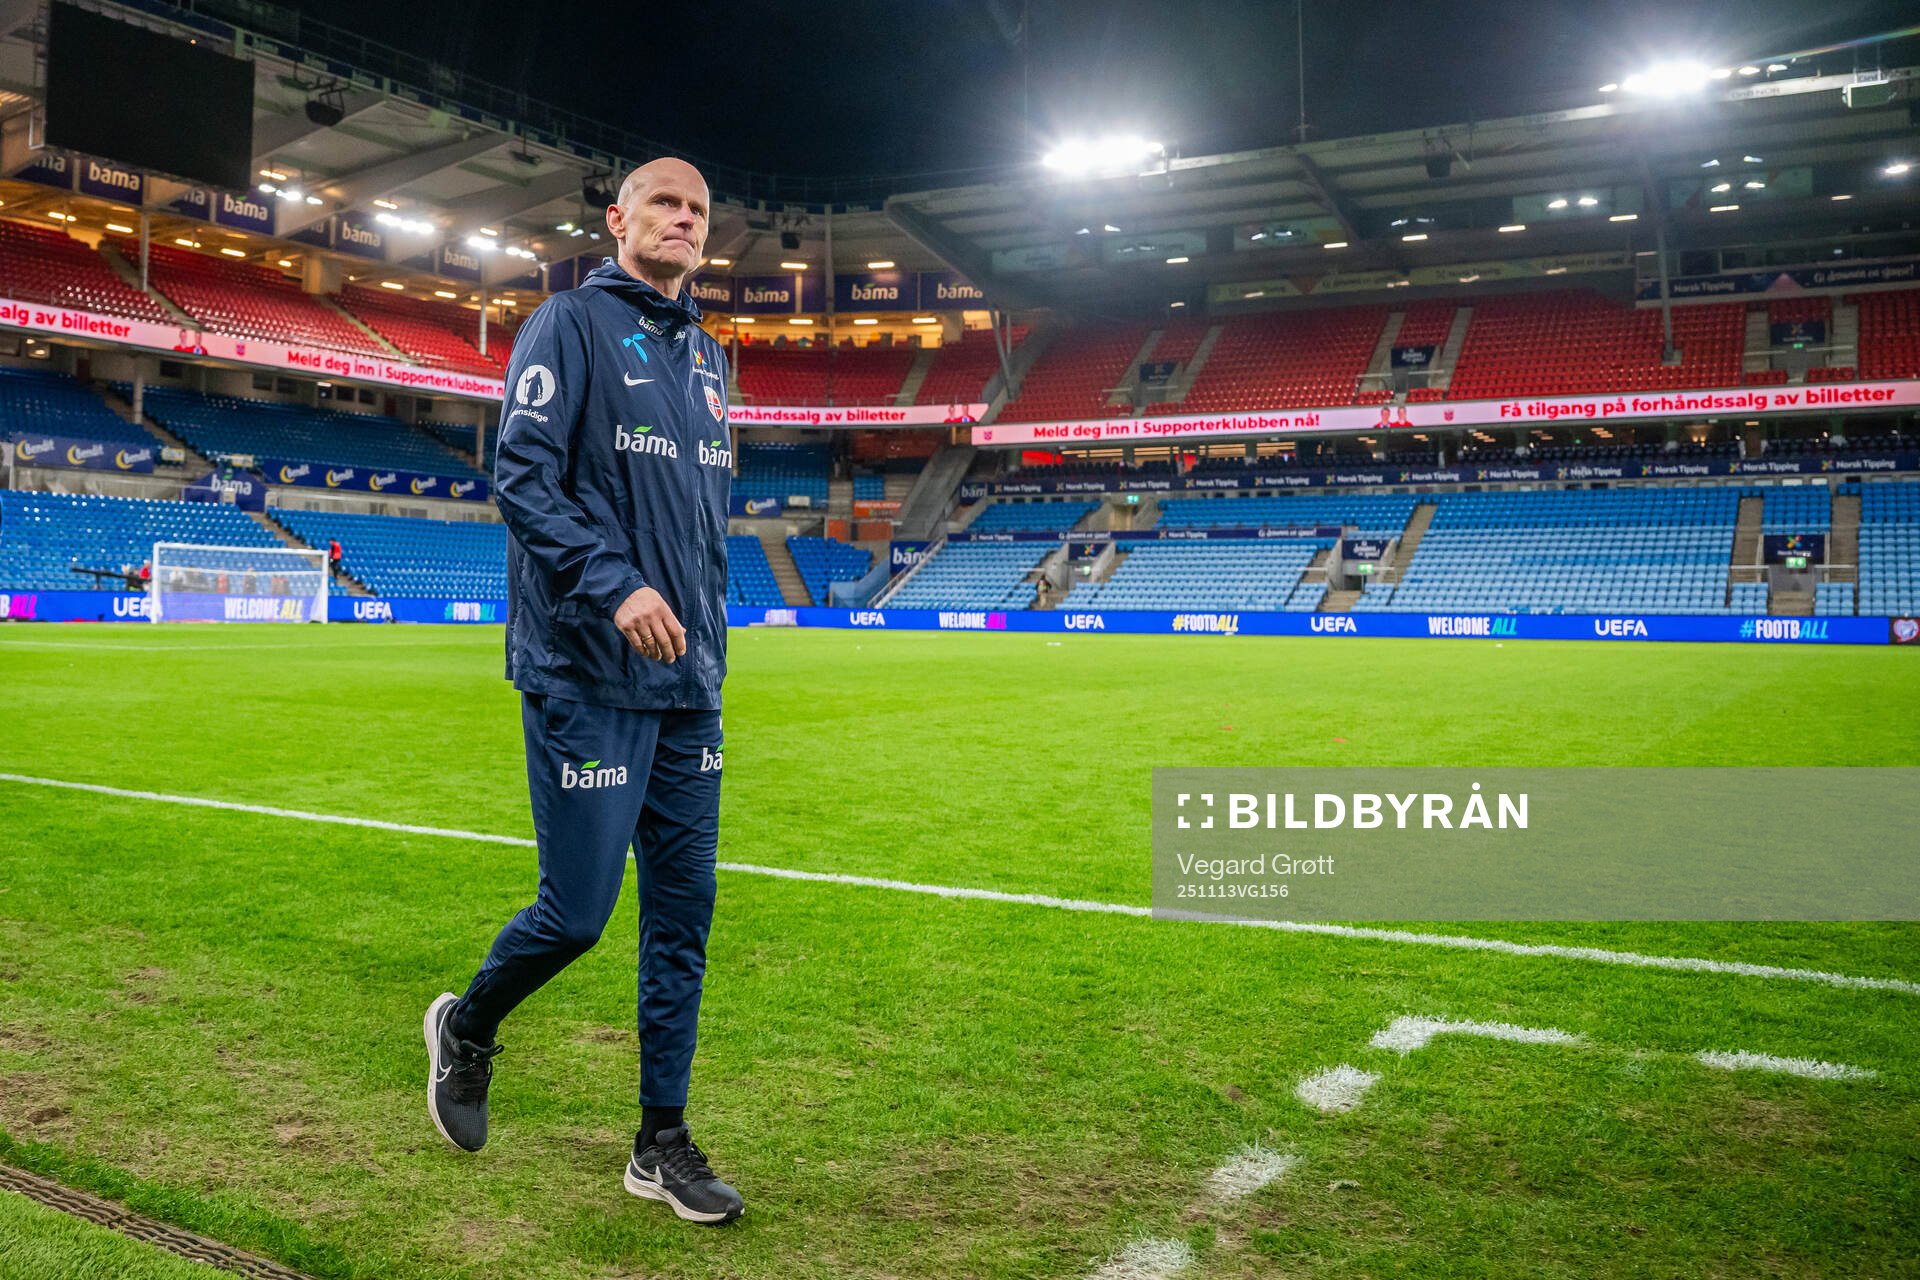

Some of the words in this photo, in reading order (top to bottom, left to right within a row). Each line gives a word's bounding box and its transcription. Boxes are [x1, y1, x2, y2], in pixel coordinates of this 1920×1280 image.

[88, 161, 141, 191] bama
[223, 193, 268, 221] bama
[341, 222, 381, 247] bama
[444, 250, 480, 271] bama
[690, 281, 730, 302] bama
[744, 286, 790, 304] bama
[851, 283, 899, 301] bama
[0, 304, 29, 326] alg
[35, 314, 57, 326] av
[61, 313, 131, 338] billetter
[639, 316, 663, 337] bama
[288, 351, 321, 367] Meld
[325, 357, 350, 376] deg
[354, 359, 375, 376] inn
[386, 366, 494, 395] Supporterklubben
[1501, 402, 1522, 417] Få
[1528, 401, 1597, 419] tilgang
[1602, 396, 1627, 415] på
[1632, 393, 1768, 412] forhåndssalg
[1774, 394, 1800, 405] av
[1806, 387, 1896, 404] billetter
[728, 408, 821, 425] orhåndssalg
[825, 411, 842, 422] av
[846, 409, 906, 422] billetter
[1034, 425, 1069, 438] Meld
[1073, 423, 1101, 439] deg
[1106, 421, 1130, 435] inn
[1134, 421, 1139, 434] i
[1143, 413, 1289, 435] Supporterklubben
[1294, 412, 1320, 427] nå!
[615, 424, 678, 459] bama
[698, 440, 733, 469] bam
[224, 598, 280, 619] WELCOME
[280, 598, 303, 619] ALL
[354, 601, 393, 620] UEFA
[850, 612, 885, 626] UEFA
[939, 612, 986, 629] WELCOME
[986, 613, 1007, 629] ALL
[1064, 614, 1105, 630] UEFA
[1172, 614, 1239, 632] #FOOTBALL
[1311, 617, 1358, 632] UEFA
[1428, 617, 1491, 636] WELCOME
[1491, 617, 1518, 636] ALL
[1594, 619, 1649, 637] UEFA
[1739, 619, 1829, 640] #FOOTBALL
[700, 747, 722, 772] ba
[561, 761, 628, 789] bama
